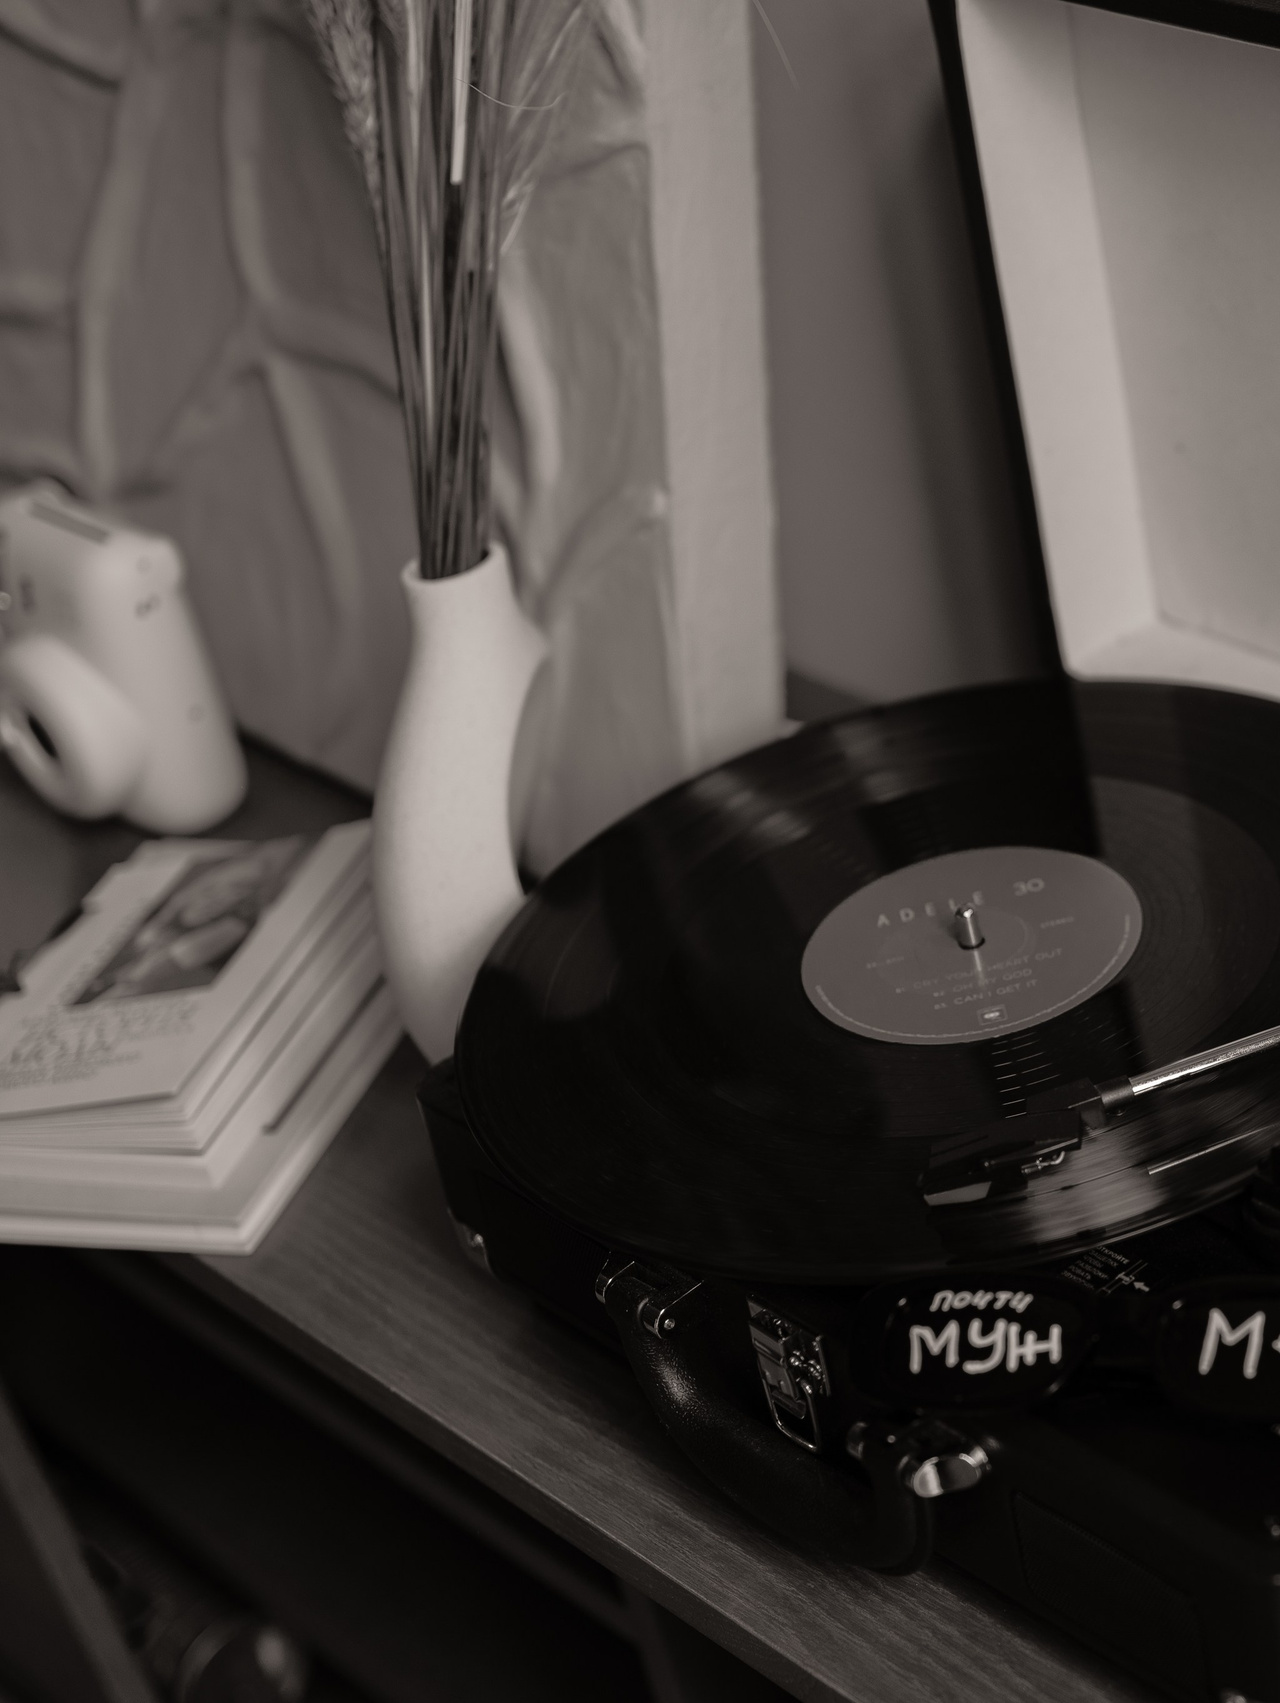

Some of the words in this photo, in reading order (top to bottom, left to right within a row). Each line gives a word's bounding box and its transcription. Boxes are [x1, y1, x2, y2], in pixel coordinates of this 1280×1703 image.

[877, 889, 985, 928] ADELE
[1012, 877, 1046, 897] 30
[1034, 947, 1063, 961] OUT
[1001, 968, 1033, 982] GOD
[952, 992, 985, 1006] CAN
[995, 982, 1022, 996] GET
[909, 1318, 1063, 1375] МУЖ
